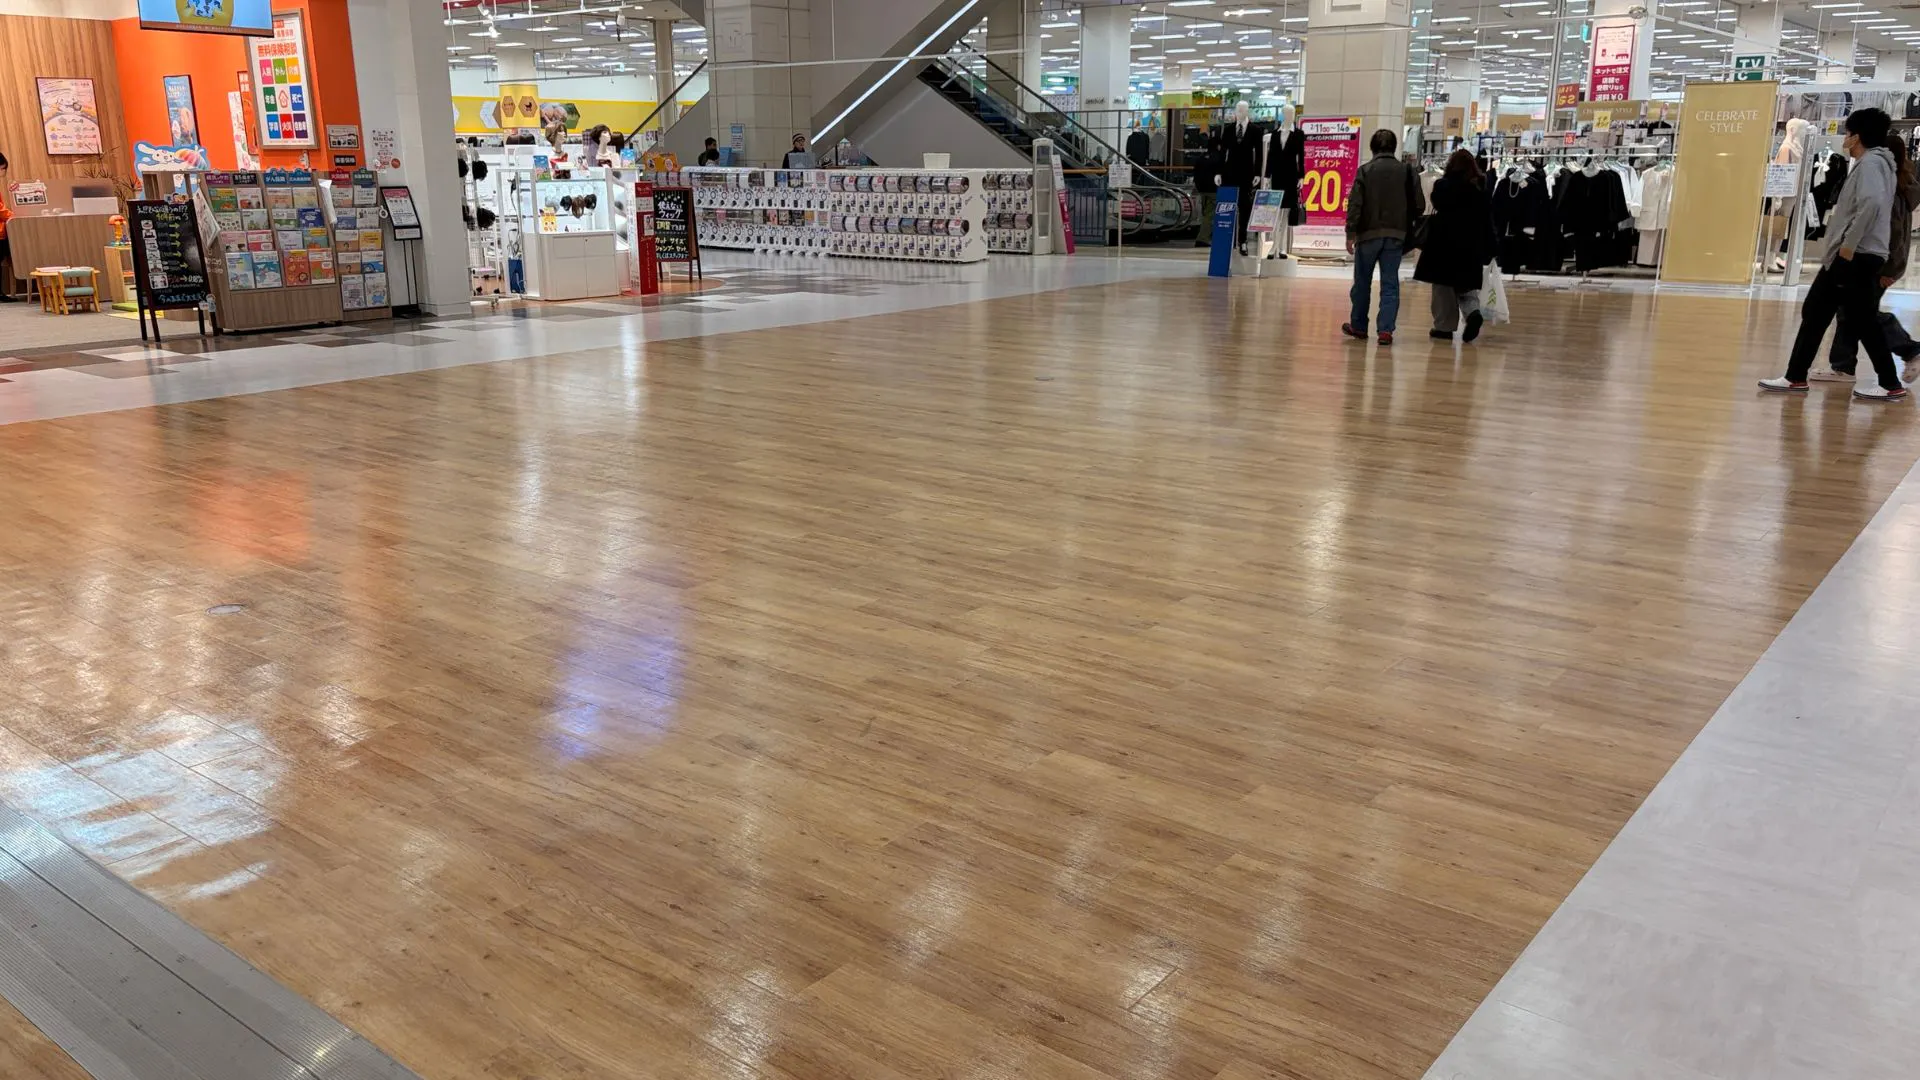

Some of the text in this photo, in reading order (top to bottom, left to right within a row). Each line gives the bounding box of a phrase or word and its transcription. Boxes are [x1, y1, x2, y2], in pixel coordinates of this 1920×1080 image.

[258, 42, 297, 57] 無料保険相談
[1739, 58, 1761, 69] TV
[275, 67, 285, 76] がん
[1595, 67, 1630, 75] ネットで注文
[265, 95, 275, 104] 年金
[292, 94, 302, 103] 死亡
[1695, 110, 1758, 121] CELEBRATE
[282, 121, 292, 131] 火災
[1709, 122, 1743, 133] STYLE
[1314, 149, 1349, 158] スマホ決済で
[658, 201, 682, 210] 使えない
[659, 209, 683, 219] ウィッグ
